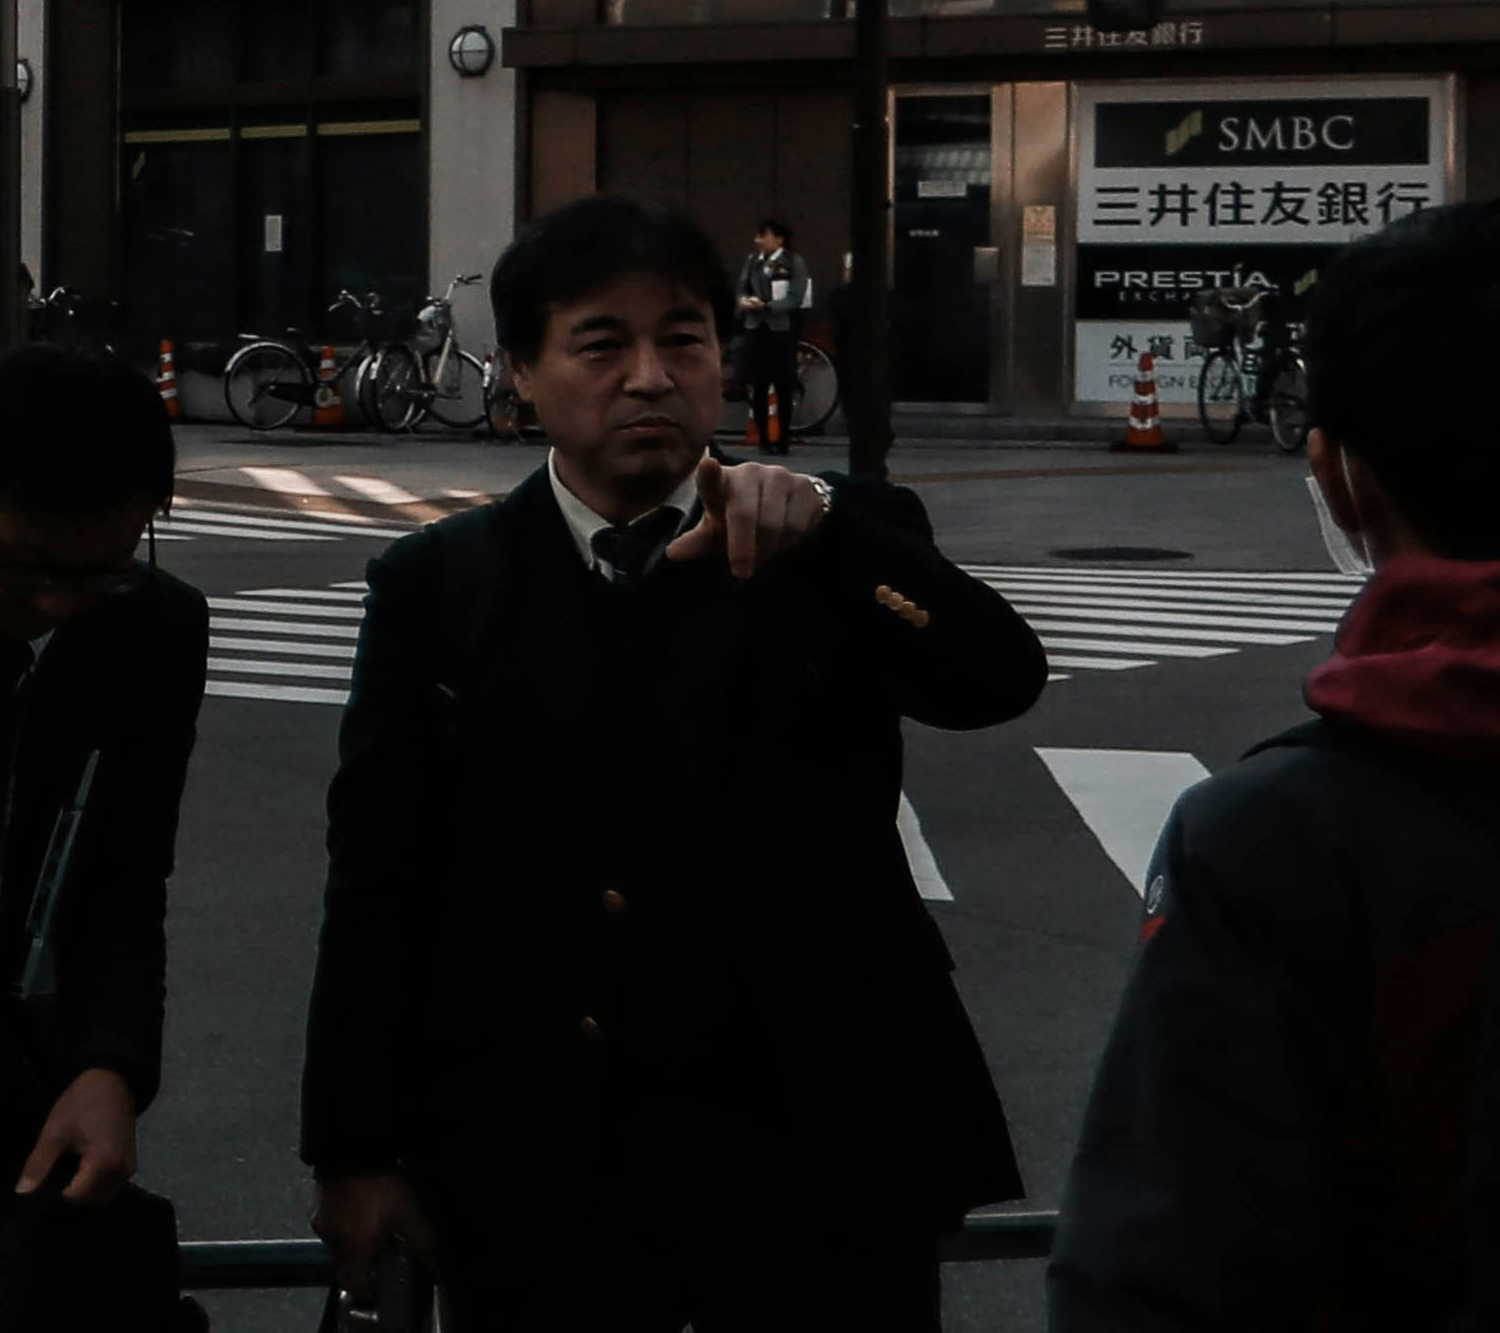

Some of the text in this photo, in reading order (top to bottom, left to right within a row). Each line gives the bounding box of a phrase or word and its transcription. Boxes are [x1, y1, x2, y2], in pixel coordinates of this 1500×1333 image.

[1219, 116, 1355, 151] SMBC
[1093, 181, 1431, 226] 三井住友銀行
